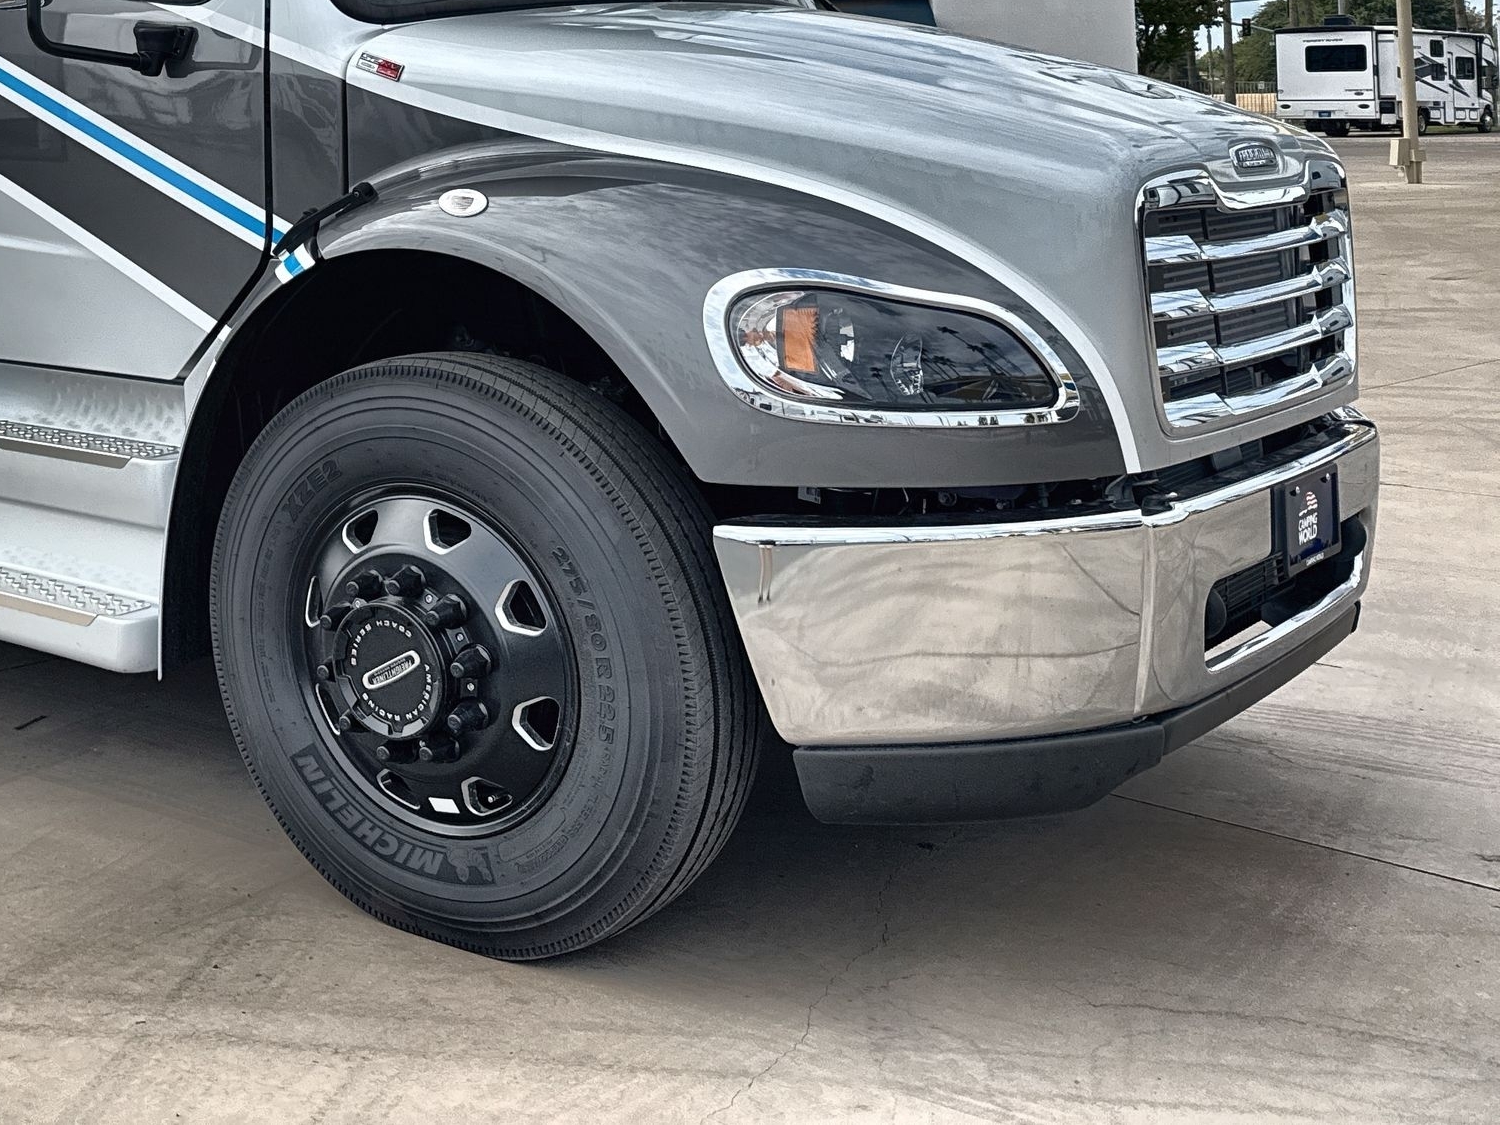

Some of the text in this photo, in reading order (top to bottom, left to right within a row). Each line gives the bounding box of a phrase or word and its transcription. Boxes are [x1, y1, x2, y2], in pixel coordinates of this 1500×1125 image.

[282, 459, 342, 523] XZE2
[350, 620, 412, 666] COACH SERIES
[362, 692, 400, 721] RACING
[405, 663, 432, 719] AMERICAN
[296, 754, 444, 875] MICHELIN
